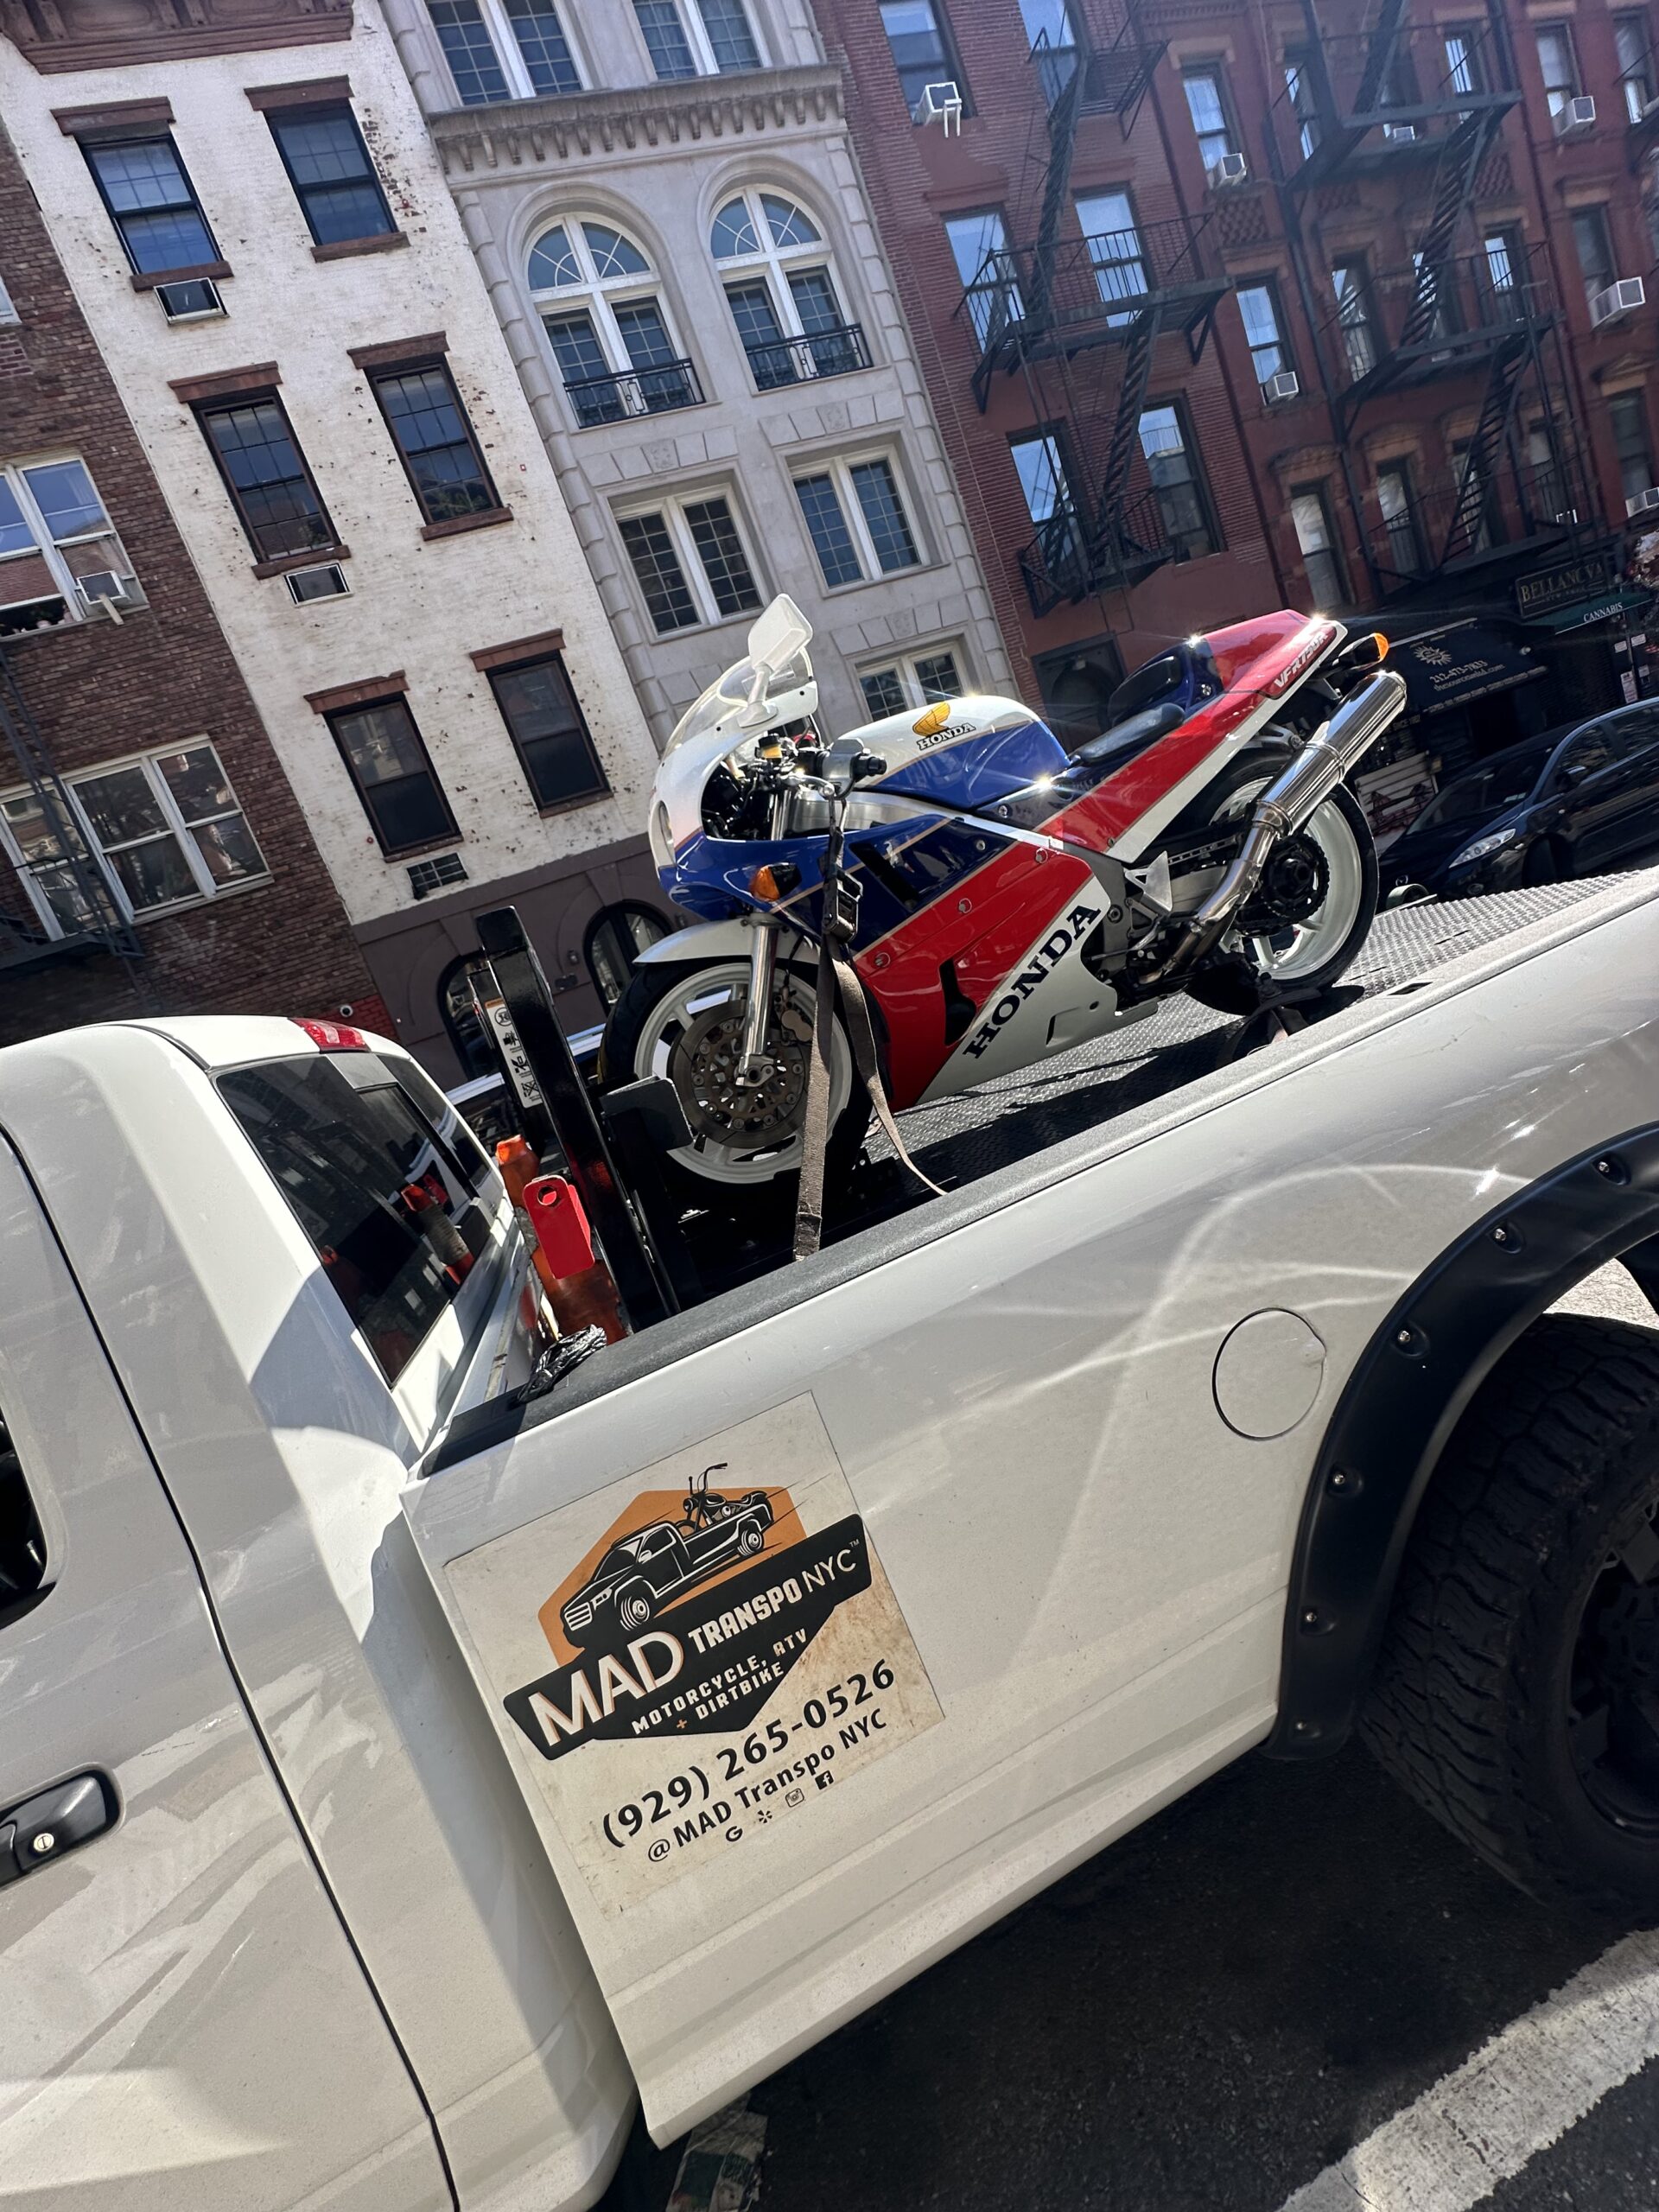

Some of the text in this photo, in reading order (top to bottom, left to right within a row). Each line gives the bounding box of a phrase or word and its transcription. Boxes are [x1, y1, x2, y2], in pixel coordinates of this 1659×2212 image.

[1274, 632, 1328, 688] VFR750R
[1583, 602, 1624, 622] CANNABIS
[917, 722, 976, 751] HONDA
[963, 906, 1101, 1058] HONDA
[528, 1630, 683, 1747] MAD
[688, 1578, 804, 1654] TRANSPO
[801, 1548, 857, 1592] NYC
[631, 1628, 808, 1735] MOTORCYCLE, ATV
[696, 1662, 785, 1720] DIRTBIKE
[603, 1659, 894, 1847] (929) 265-0526
[734, 1744, 835, 1808] Transpo
[838, 1708, 887, 1749] NYC
